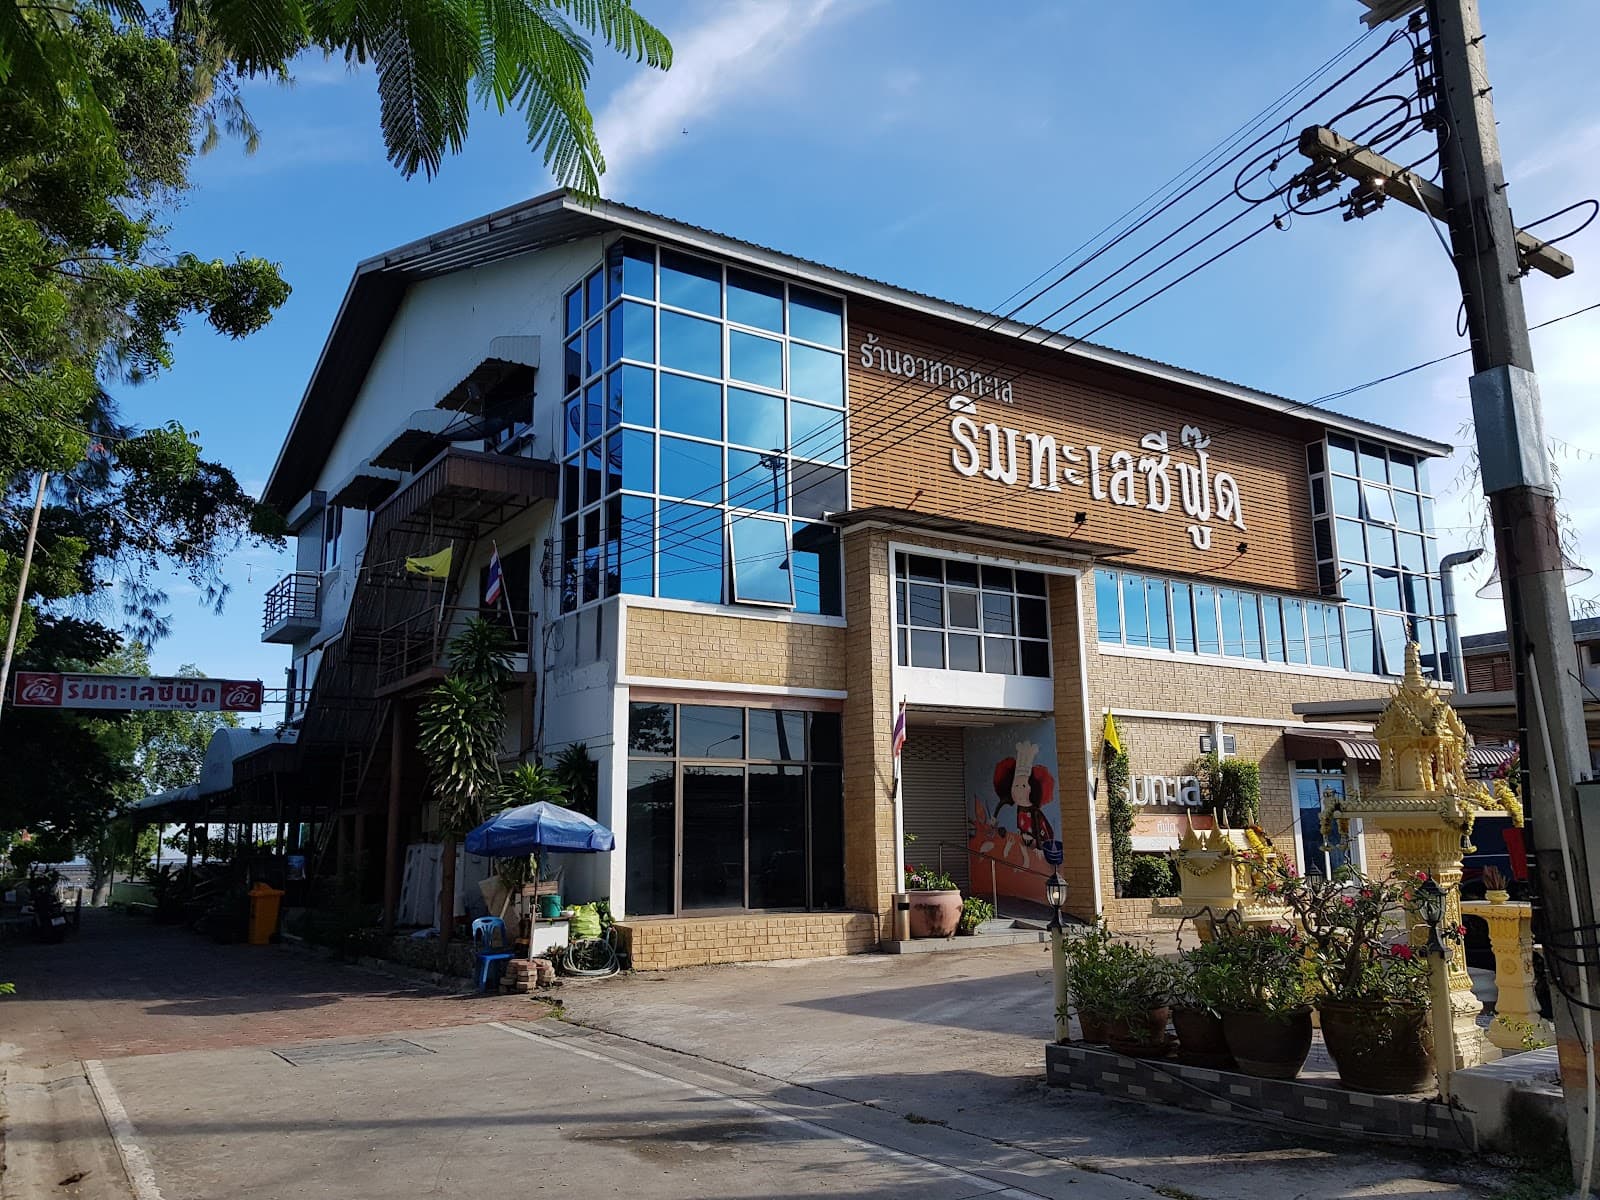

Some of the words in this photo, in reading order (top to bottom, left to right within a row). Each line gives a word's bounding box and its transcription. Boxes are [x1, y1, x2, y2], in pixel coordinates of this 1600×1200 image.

[860, 332, 1014, 404] ร้านอาหารทะเล
